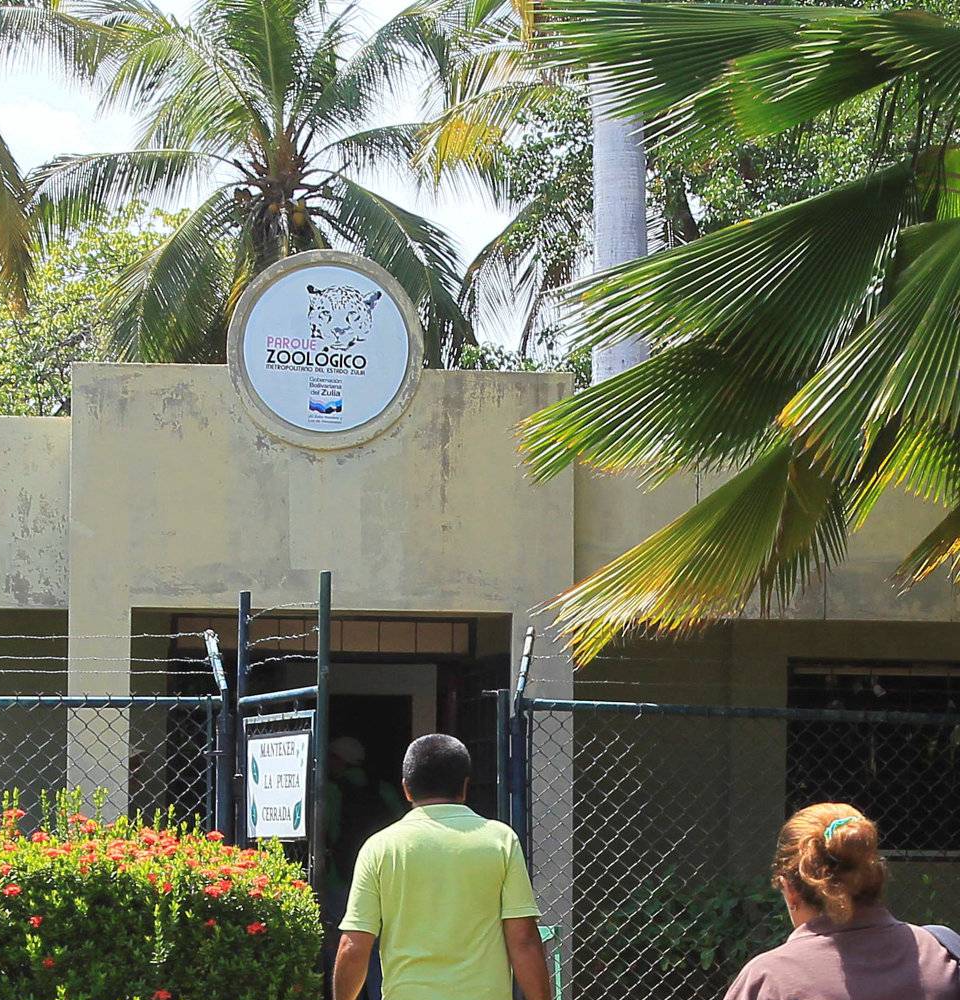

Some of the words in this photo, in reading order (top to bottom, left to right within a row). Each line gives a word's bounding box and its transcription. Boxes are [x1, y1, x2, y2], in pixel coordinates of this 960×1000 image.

[267, 336, 317, 350] PARQUE
[266, 347, 367, 369] ZOOLÓGICO
[265, 364, 313, 373] METROPOLITANO
[260, 742, 295, 757] MANTENER
[264, 775, 272, 788] LA
[277, 774, 300, 788] PUERTA
[262, 807, 292, 821] CERRADA
